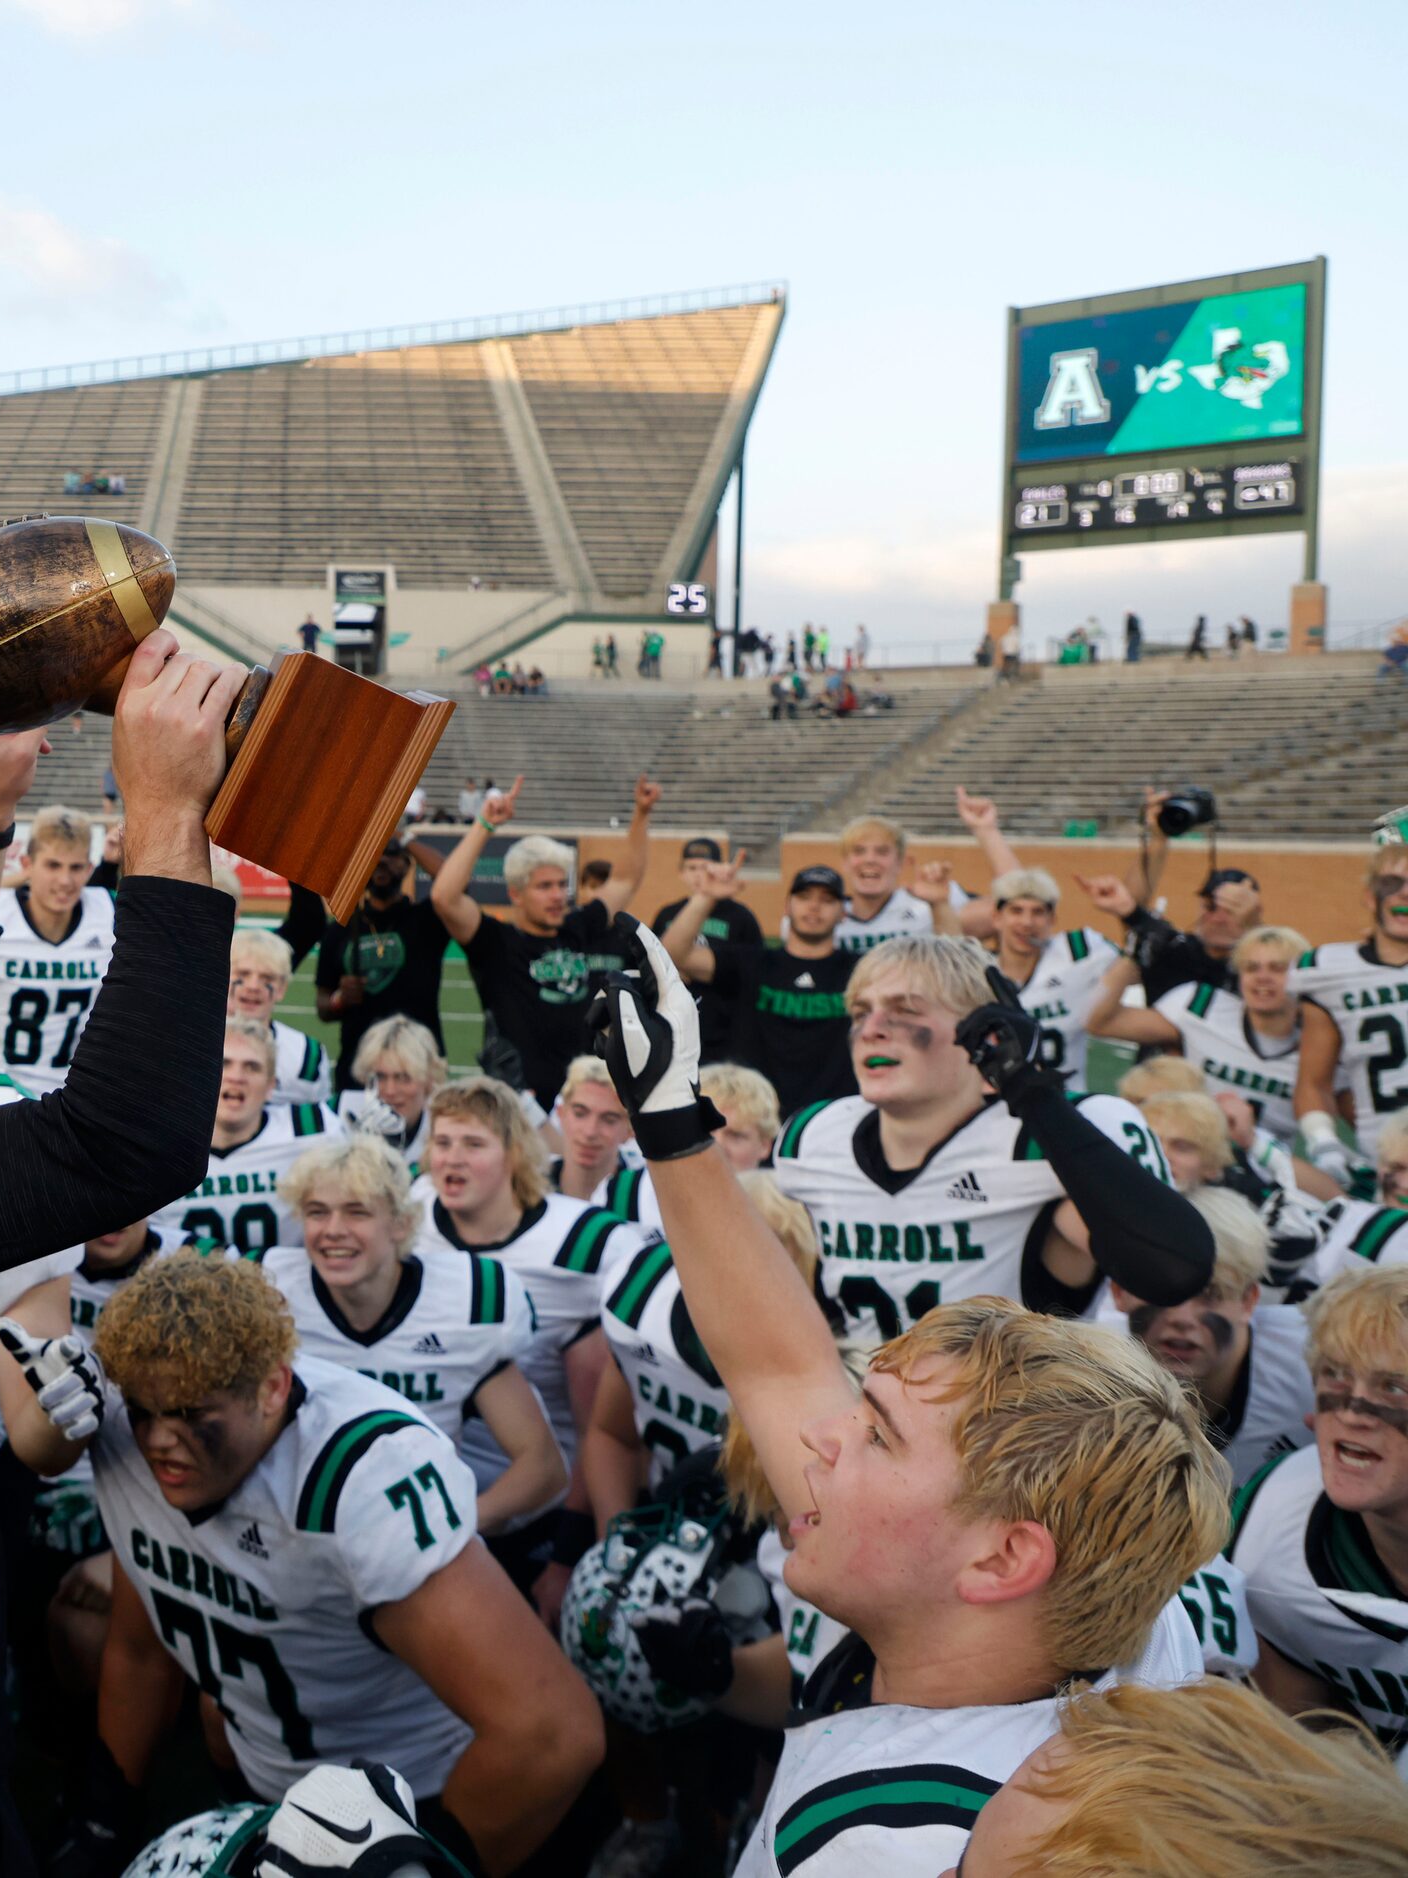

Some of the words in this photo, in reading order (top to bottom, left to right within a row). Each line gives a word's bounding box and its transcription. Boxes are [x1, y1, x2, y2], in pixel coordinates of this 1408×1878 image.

[1034, 347, 1111, 430] A
[667, 584, 707, 613] 25
[6, 960, 98, 980] CARROLL
[3, 987, 93, 1068] 87
[820, 1220, 985, 1262] CARROLL
[384, 1462, 461, 1552] 77
[131, 1527, 279, 1622] CARROLL
[150, 1586, 320, 1762] 77
